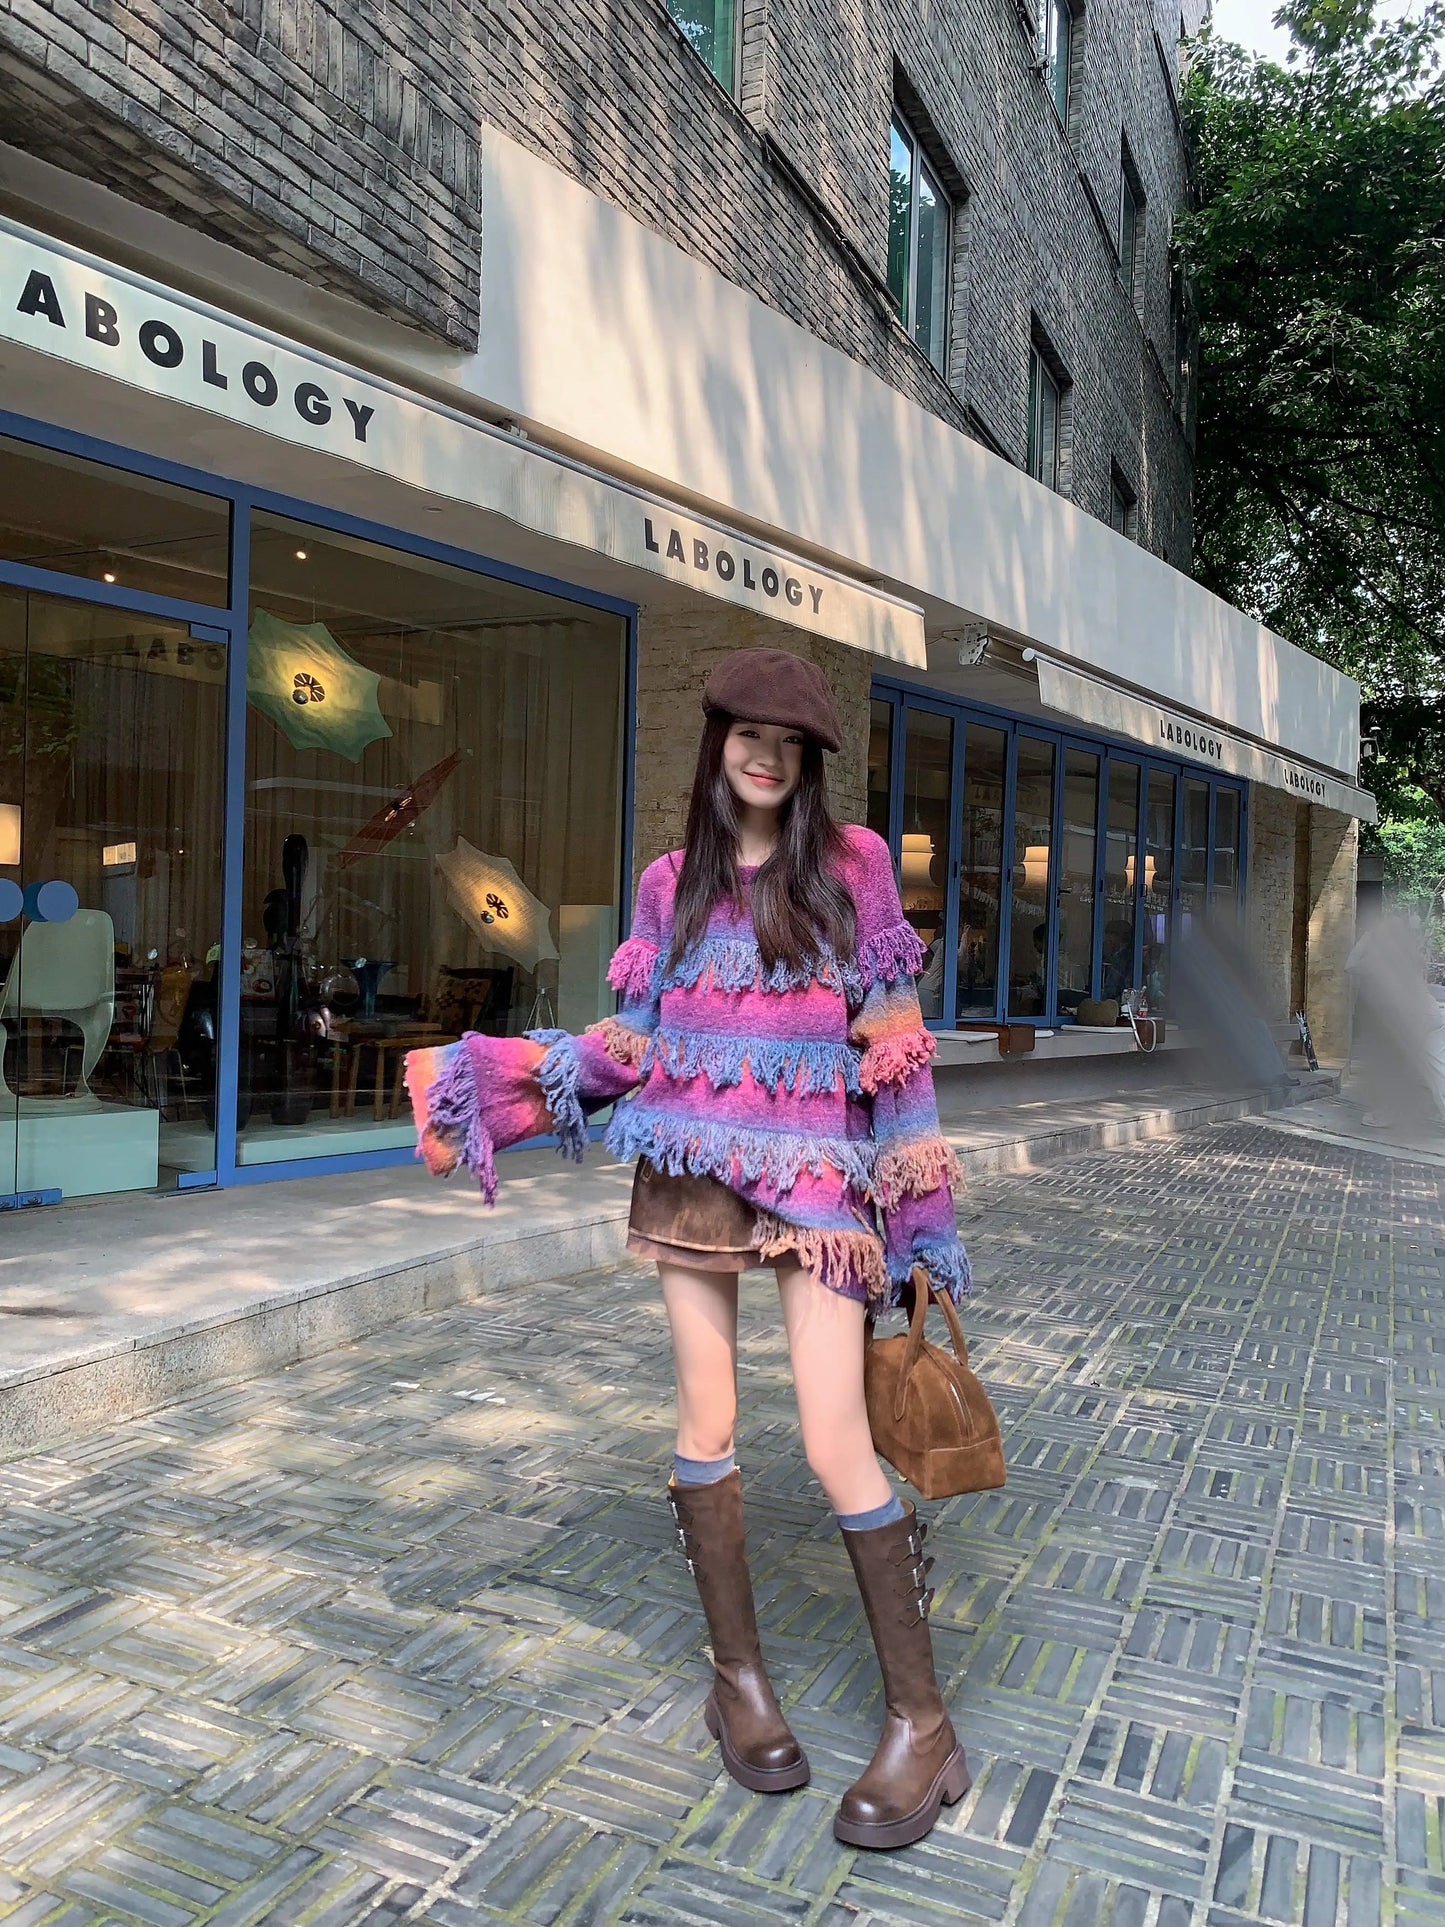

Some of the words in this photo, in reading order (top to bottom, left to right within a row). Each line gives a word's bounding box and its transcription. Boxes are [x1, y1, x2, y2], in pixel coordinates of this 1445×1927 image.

[16, 269, 375, 443] ABOLOGY
[644, 517, 823, 614] LABOLOGY
[1160, 719, 1223, 760] LABOLOGY
[1284, 768, 1326, 798] LABOLOGY
